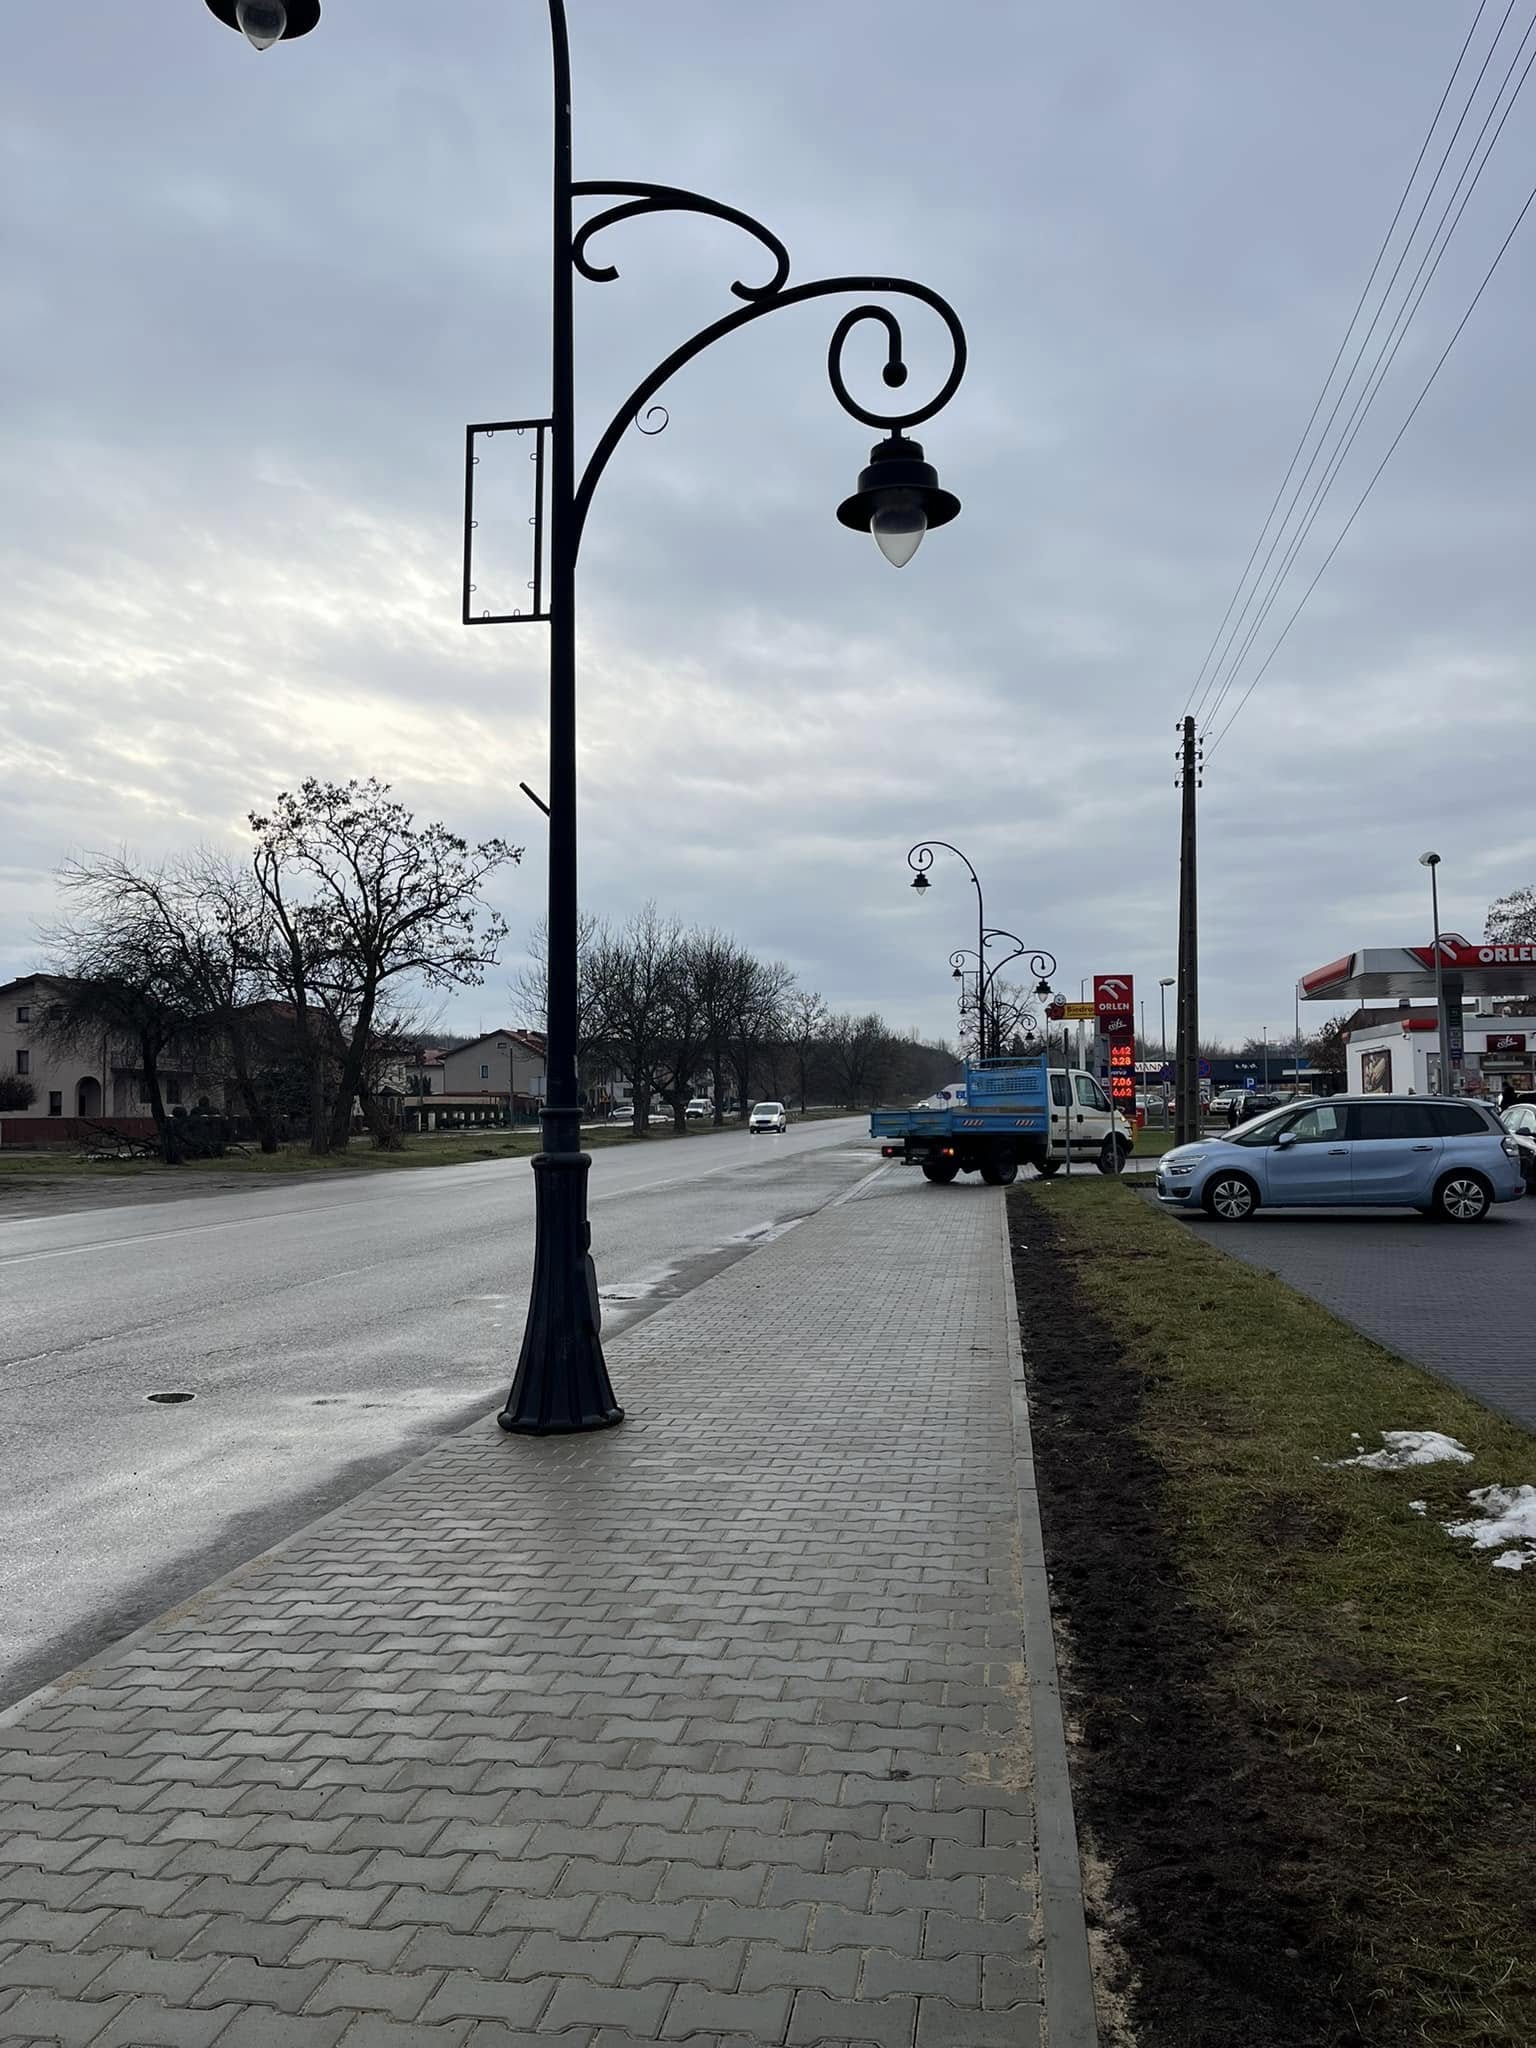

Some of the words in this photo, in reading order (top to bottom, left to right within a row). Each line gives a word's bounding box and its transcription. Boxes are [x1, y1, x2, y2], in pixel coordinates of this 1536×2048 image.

[1112, 1057, 1131, 1065] 3.28
[1113, 1077, 1132, 1086] 7.06
[1246, 1078, 1255, 1088] P
[1113, 1088, 1132, 1096] 6.62
